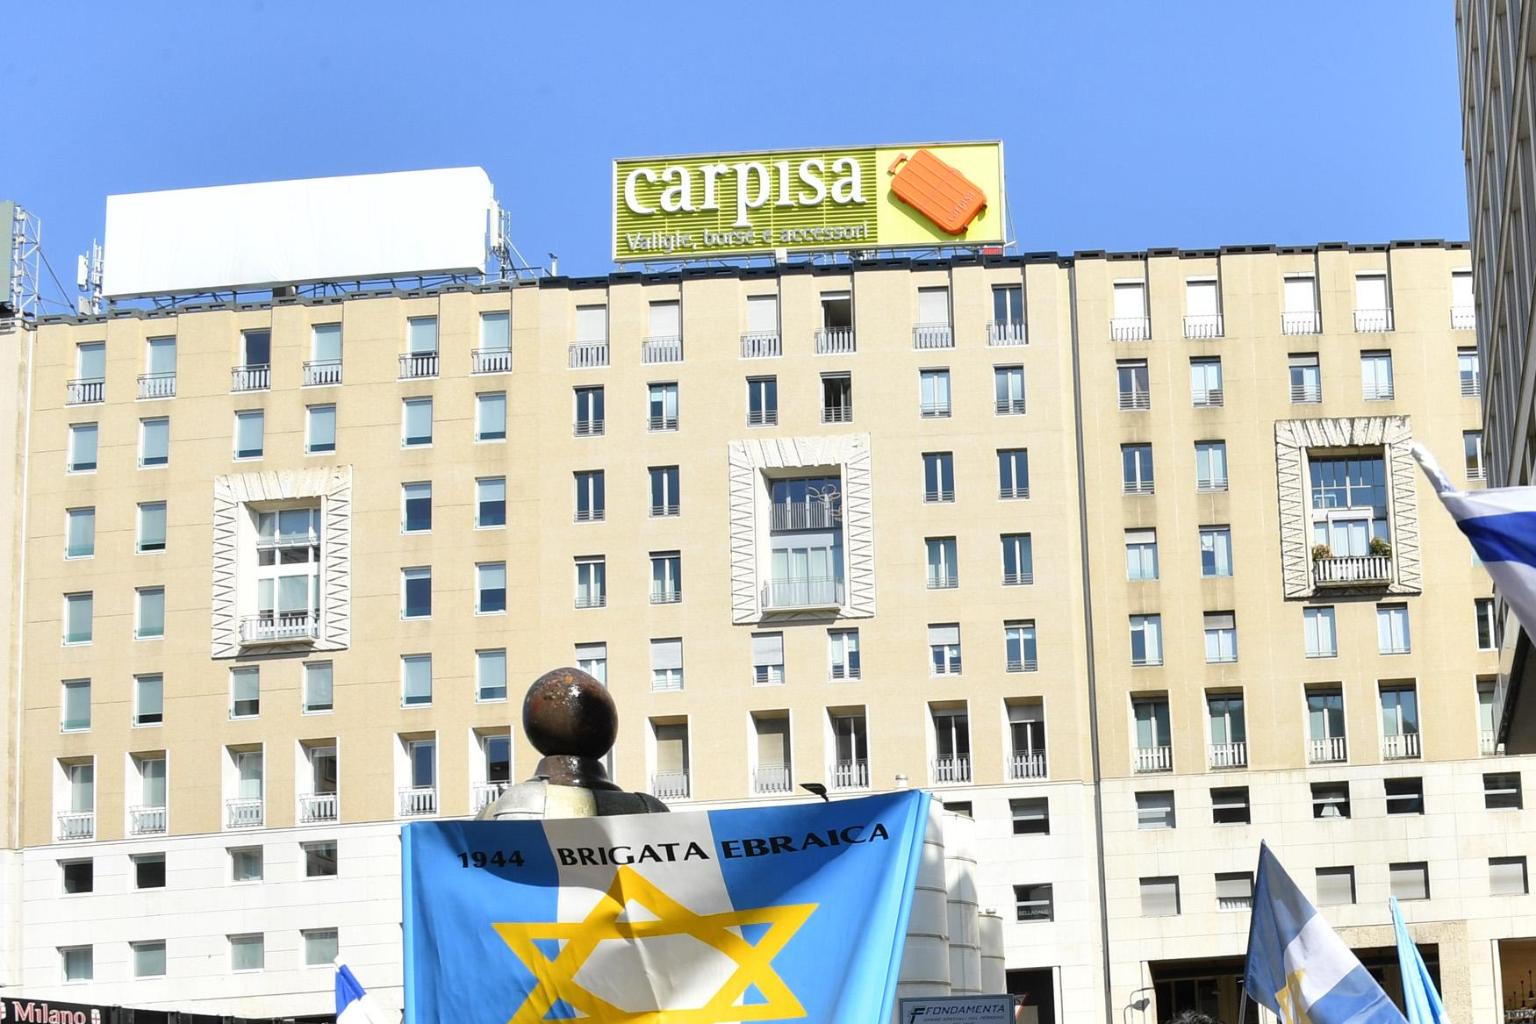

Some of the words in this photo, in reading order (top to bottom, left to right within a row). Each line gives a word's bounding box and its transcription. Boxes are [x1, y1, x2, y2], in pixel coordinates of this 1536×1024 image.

[625, 156, 867, 227] carpisa
[703, 226, 756, 246] borse
[761, 228, 772, 244] e
[780, 220, 870, 243] accessori
[457, 849, 525, 869] 1944
[559, 841, 710, 867] BRIGATA
[721, 822, 891, 861] EBRAICA
[926, 1004, 1005, 1015] FONDAMENTA
